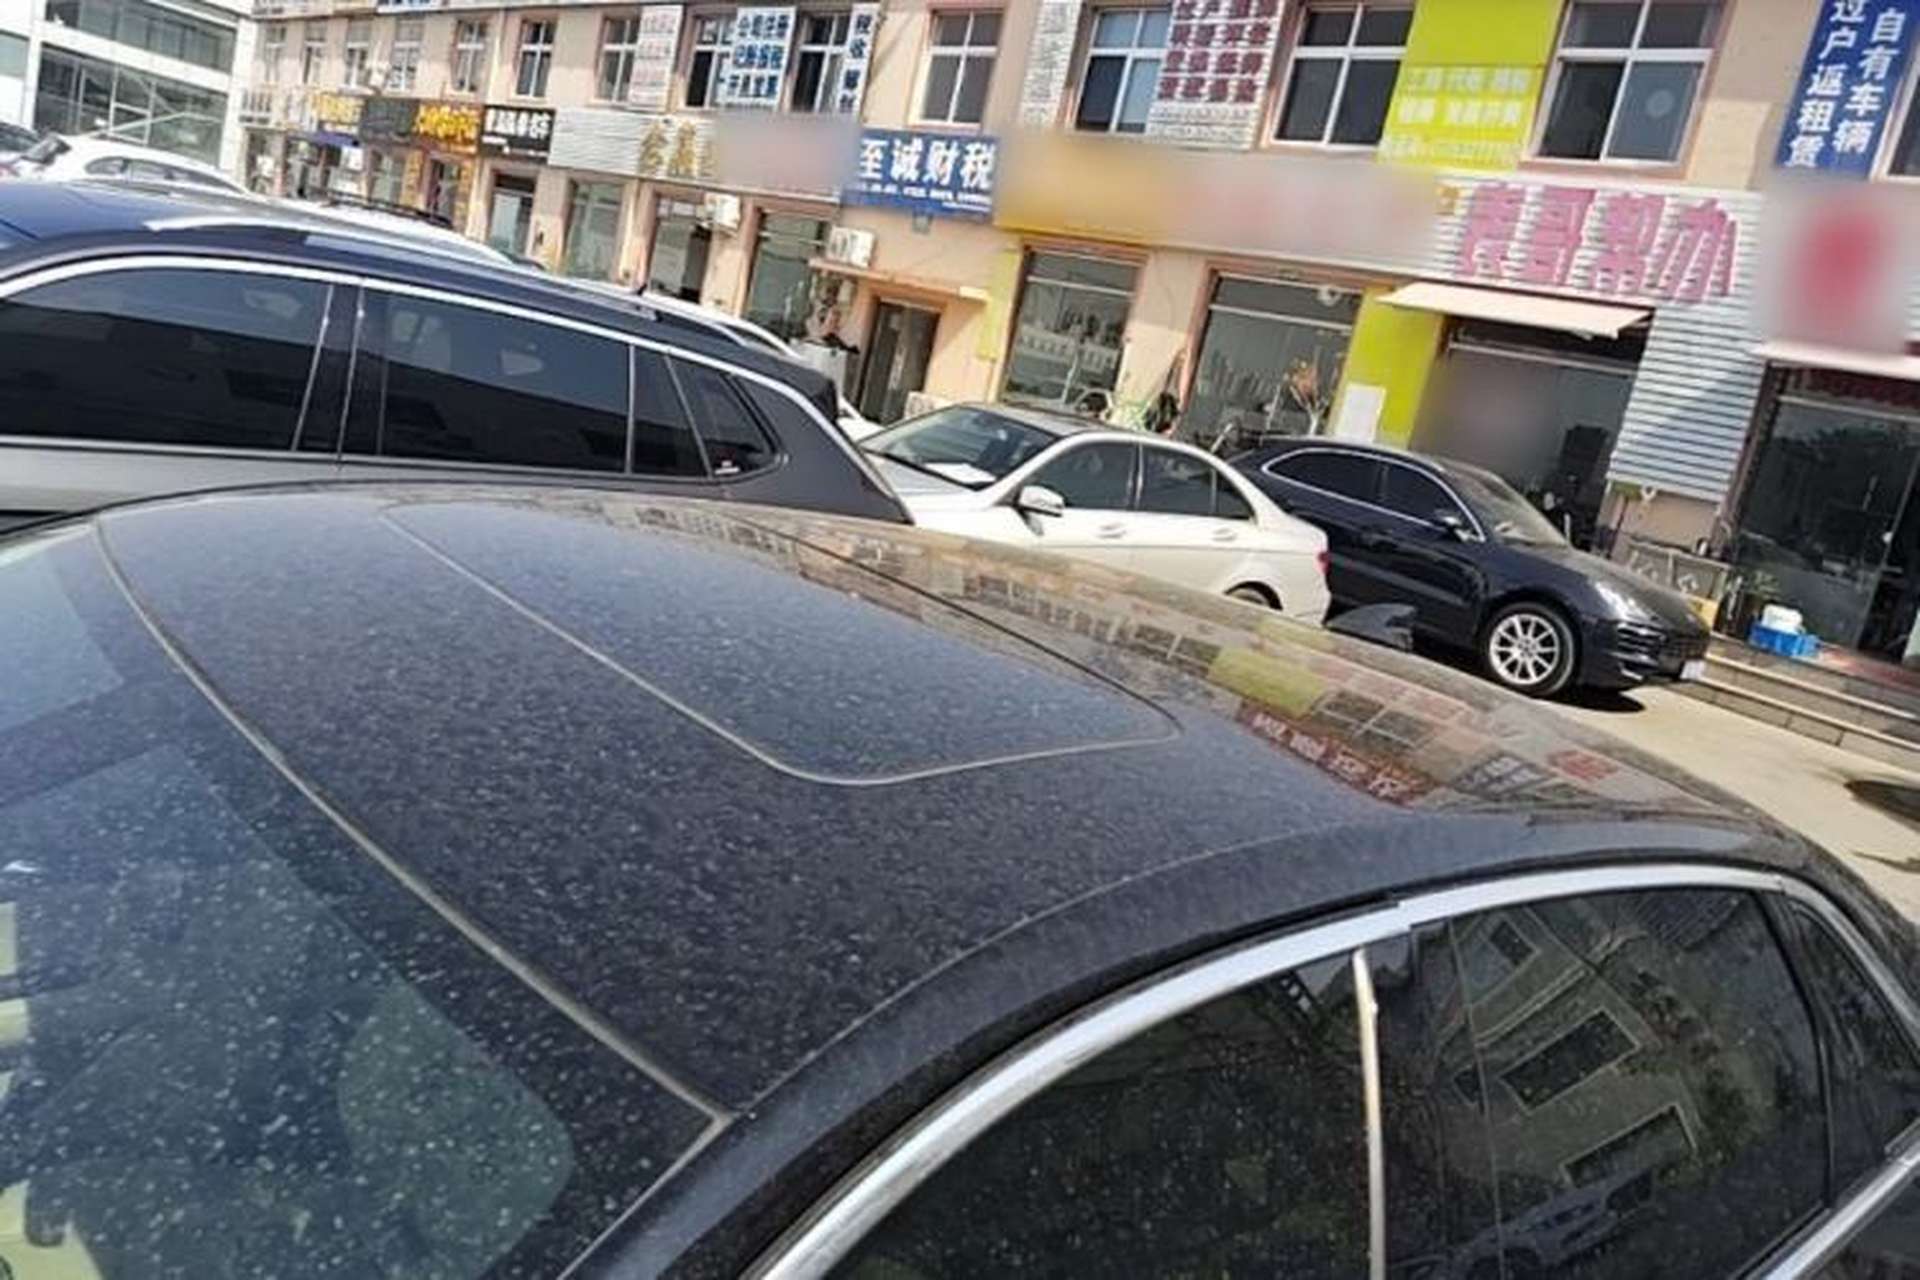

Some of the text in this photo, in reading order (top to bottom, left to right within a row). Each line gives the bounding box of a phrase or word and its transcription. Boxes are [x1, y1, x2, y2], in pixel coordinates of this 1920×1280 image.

[1831, 8, 1906, 153] 自有车辆
[859, 136, 996, 189] 至诚财税
